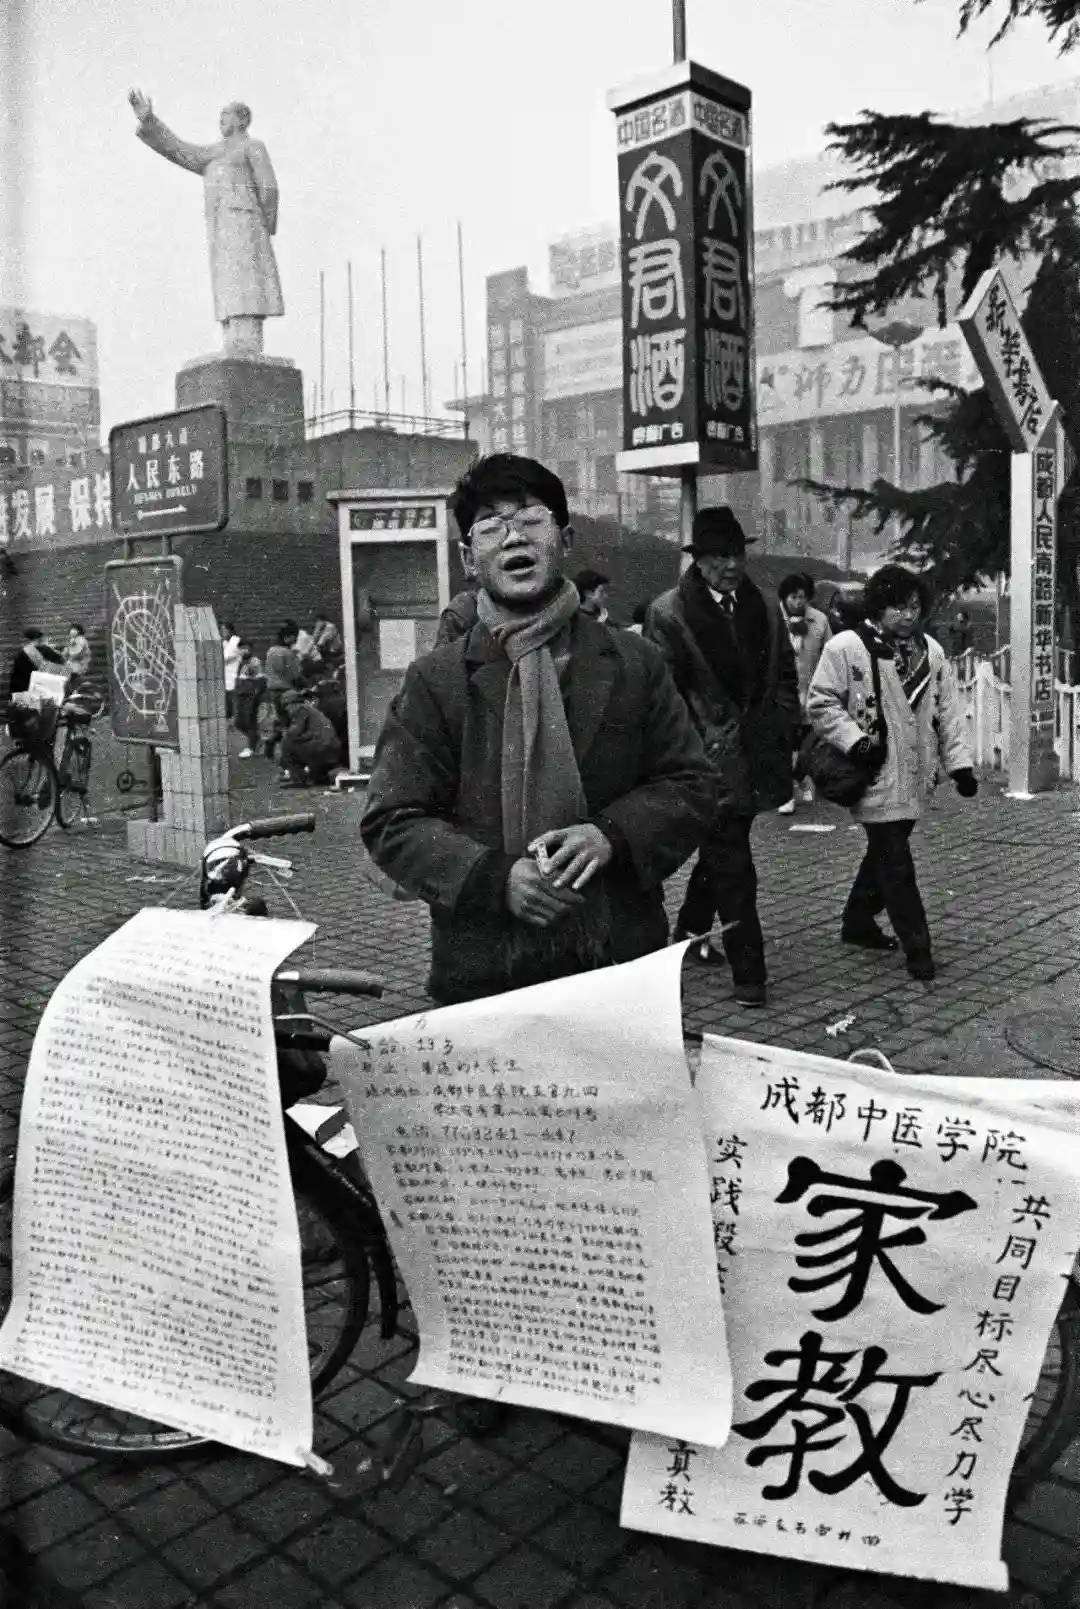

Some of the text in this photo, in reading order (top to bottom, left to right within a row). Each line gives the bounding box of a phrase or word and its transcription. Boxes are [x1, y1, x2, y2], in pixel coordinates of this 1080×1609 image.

[626, 151, 687, 418] 文君酒
[760, 1076, 1029, 1171] 成都中医学院
[731, 1155, 978, 1507] 家教
